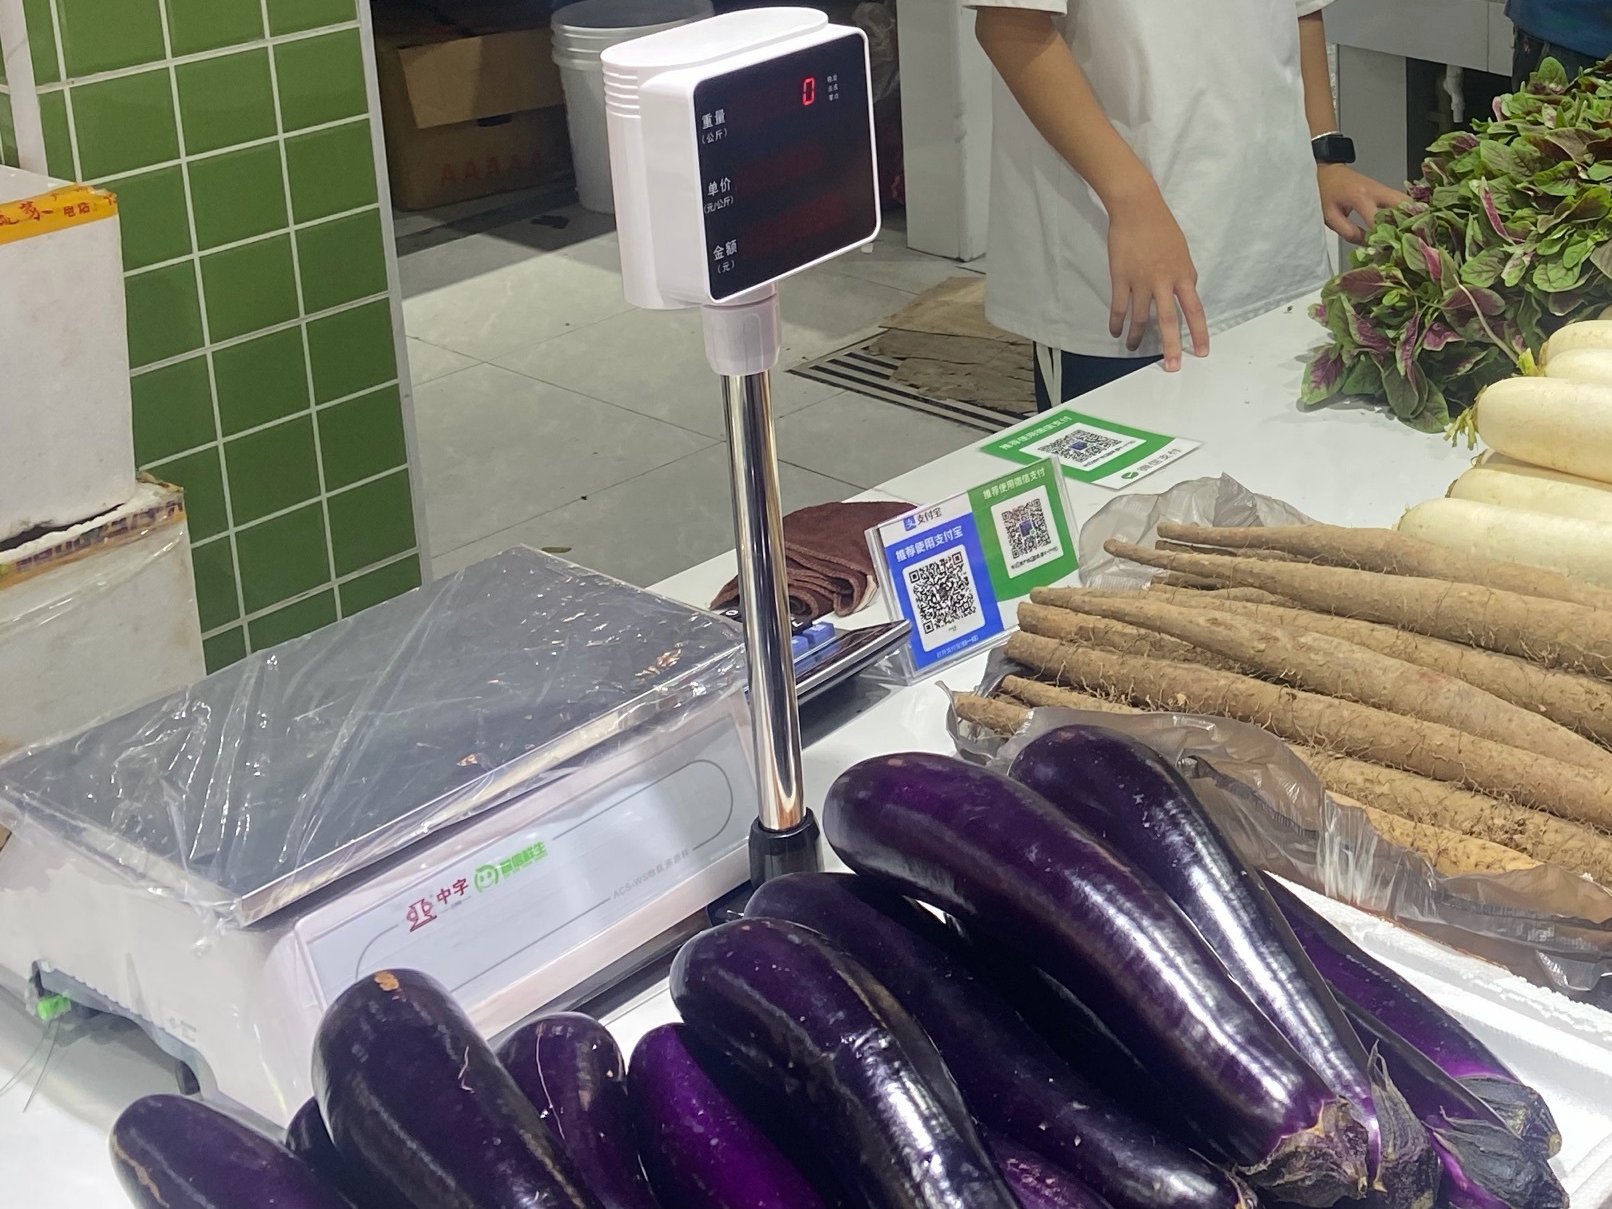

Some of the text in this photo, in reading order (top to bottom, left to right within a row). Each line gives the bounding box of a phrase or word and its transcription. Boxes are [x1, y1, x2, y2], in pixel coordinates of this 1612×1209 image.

[802, 77, 815, 105] 0
[702, 109, 725, 130] 重量
[708, 177, 731, 196] 单价
[713, 239, 738, 261] 金额
[983, 467, 1046, 500] 推荐使用微信支付
[917, 507, 942, 525] 支付宝
[895, 525, 964, 562] 推荐使用支付宝
[436, 878, 469, 904] 中字
